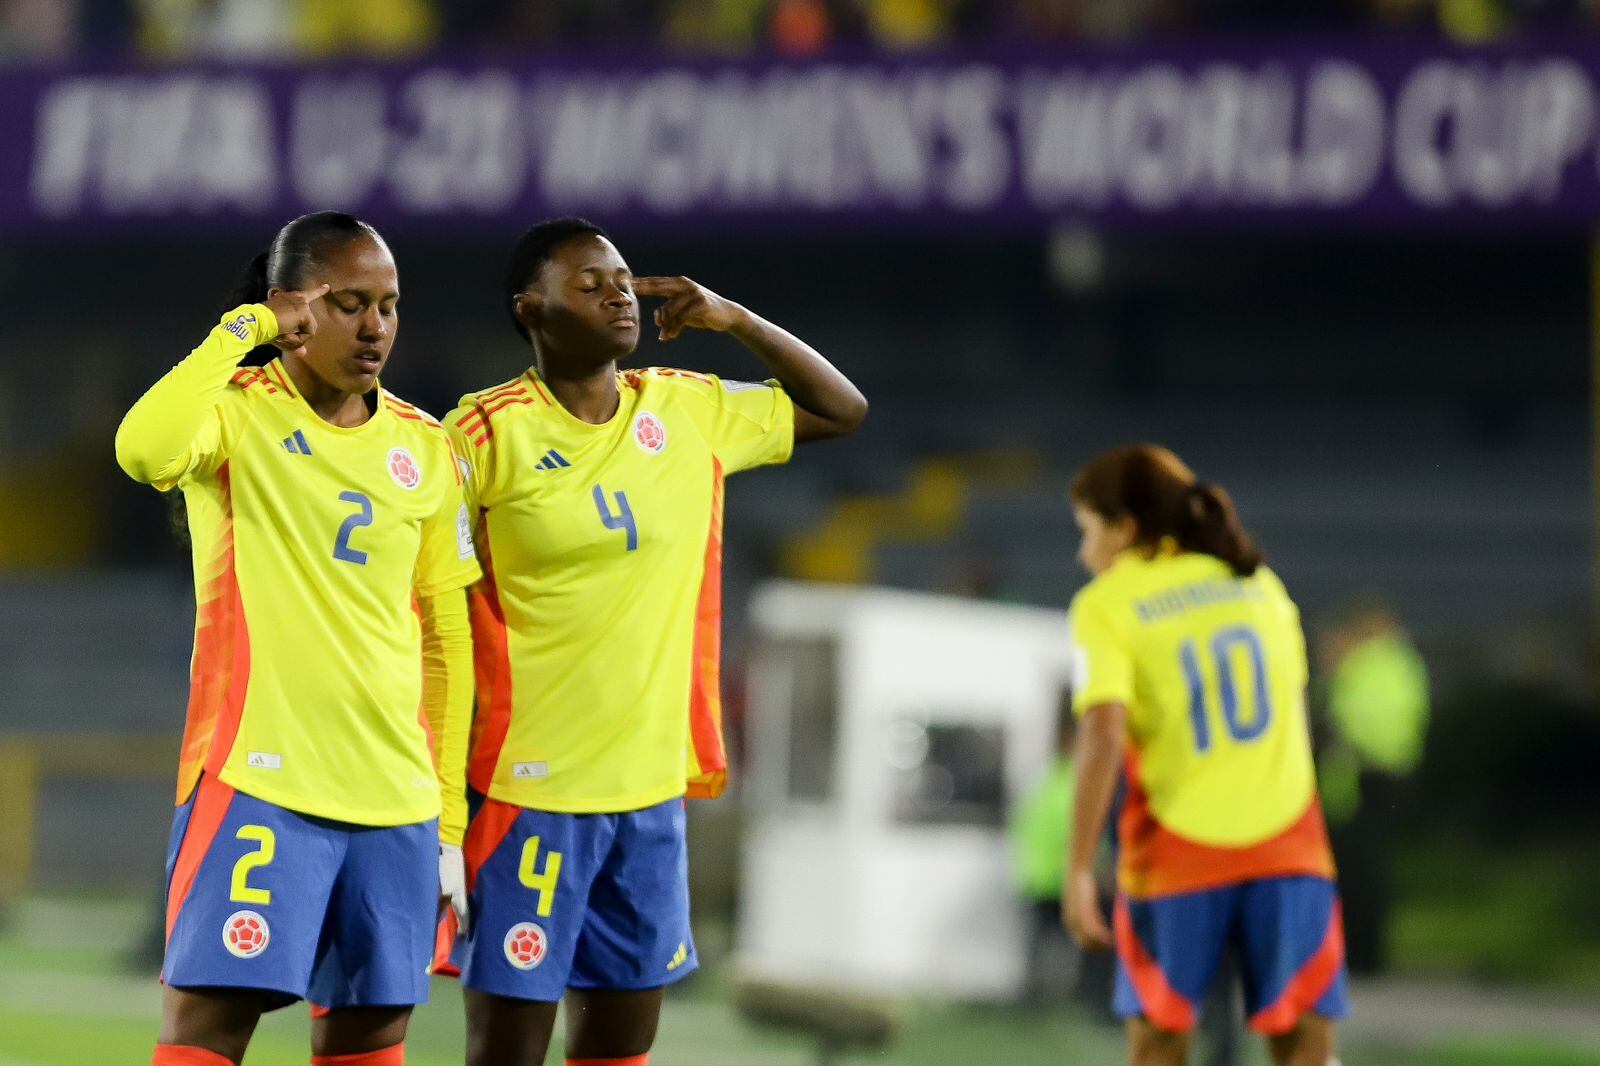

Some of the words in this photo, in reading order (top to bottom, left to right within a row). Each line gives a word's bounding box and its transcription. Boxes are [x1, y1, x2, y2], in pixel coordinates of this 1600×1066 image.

[34, 76, 278, 213] FIFA
[1019, 62, 1386, 208] WORLD
[1396, 58, 1596, 206] CUP
[333, 490, 373, 565] 2
[592, 483, 637, 551] 4
[1180, 624, 1271, 754] 10
[229, 824, 275, 905] 2
[518, 836, 562, 917] 4
